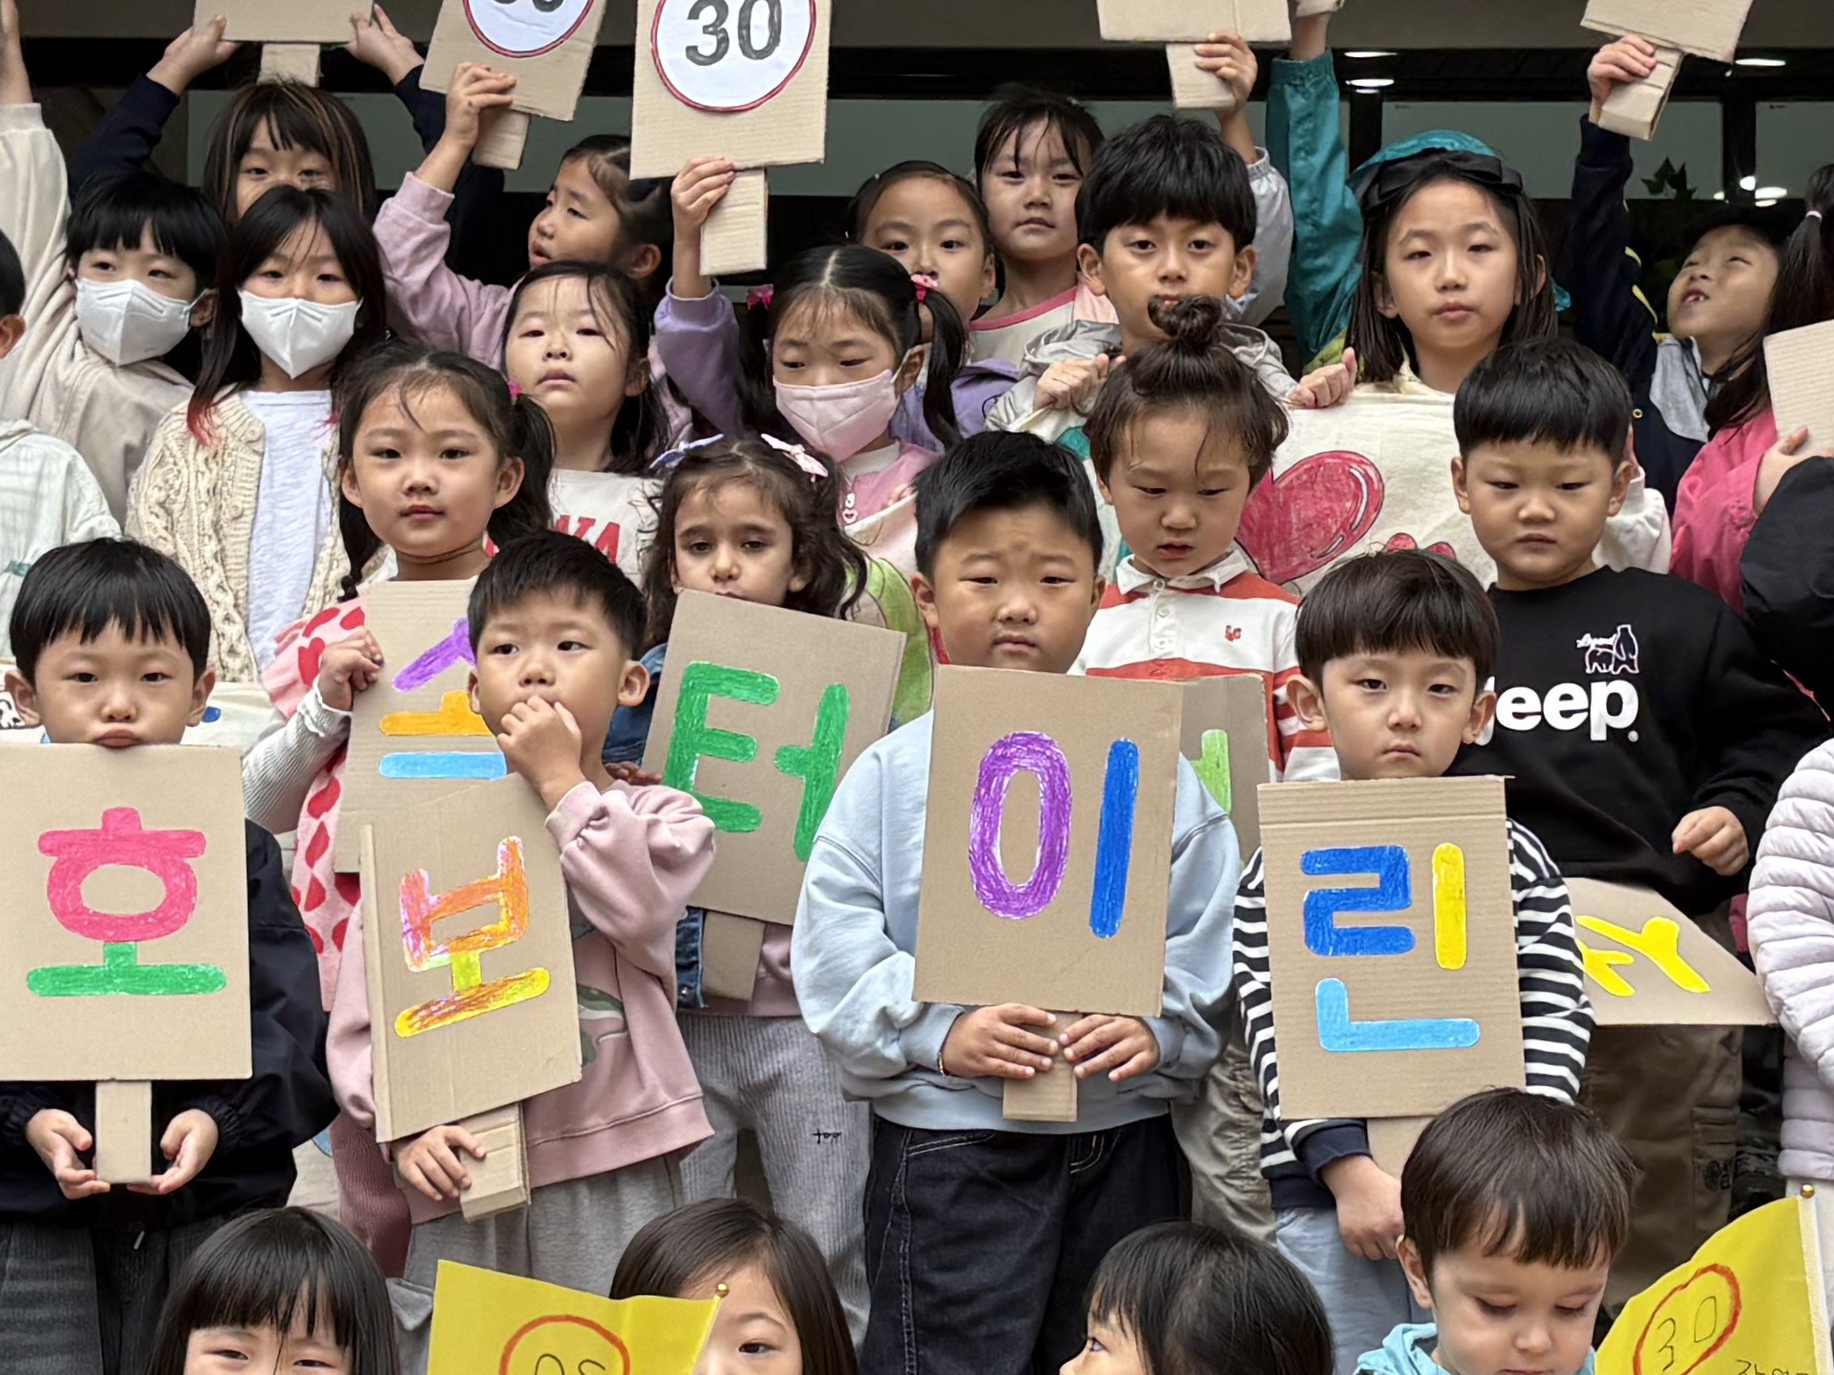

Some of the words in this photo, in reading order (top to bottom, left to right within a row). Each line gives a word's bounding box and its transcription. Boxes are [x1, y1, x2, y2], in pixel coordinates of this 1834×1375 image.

[661, 660, 851, 864] 터
[967, 729, 1141, 940] 이
[25, 805, 228, 998] 호
[393, 834, 552, 1040] 보
[1299, 841, 1483, 1053] 린
[1656, 1295, 1717, 1372] 30
